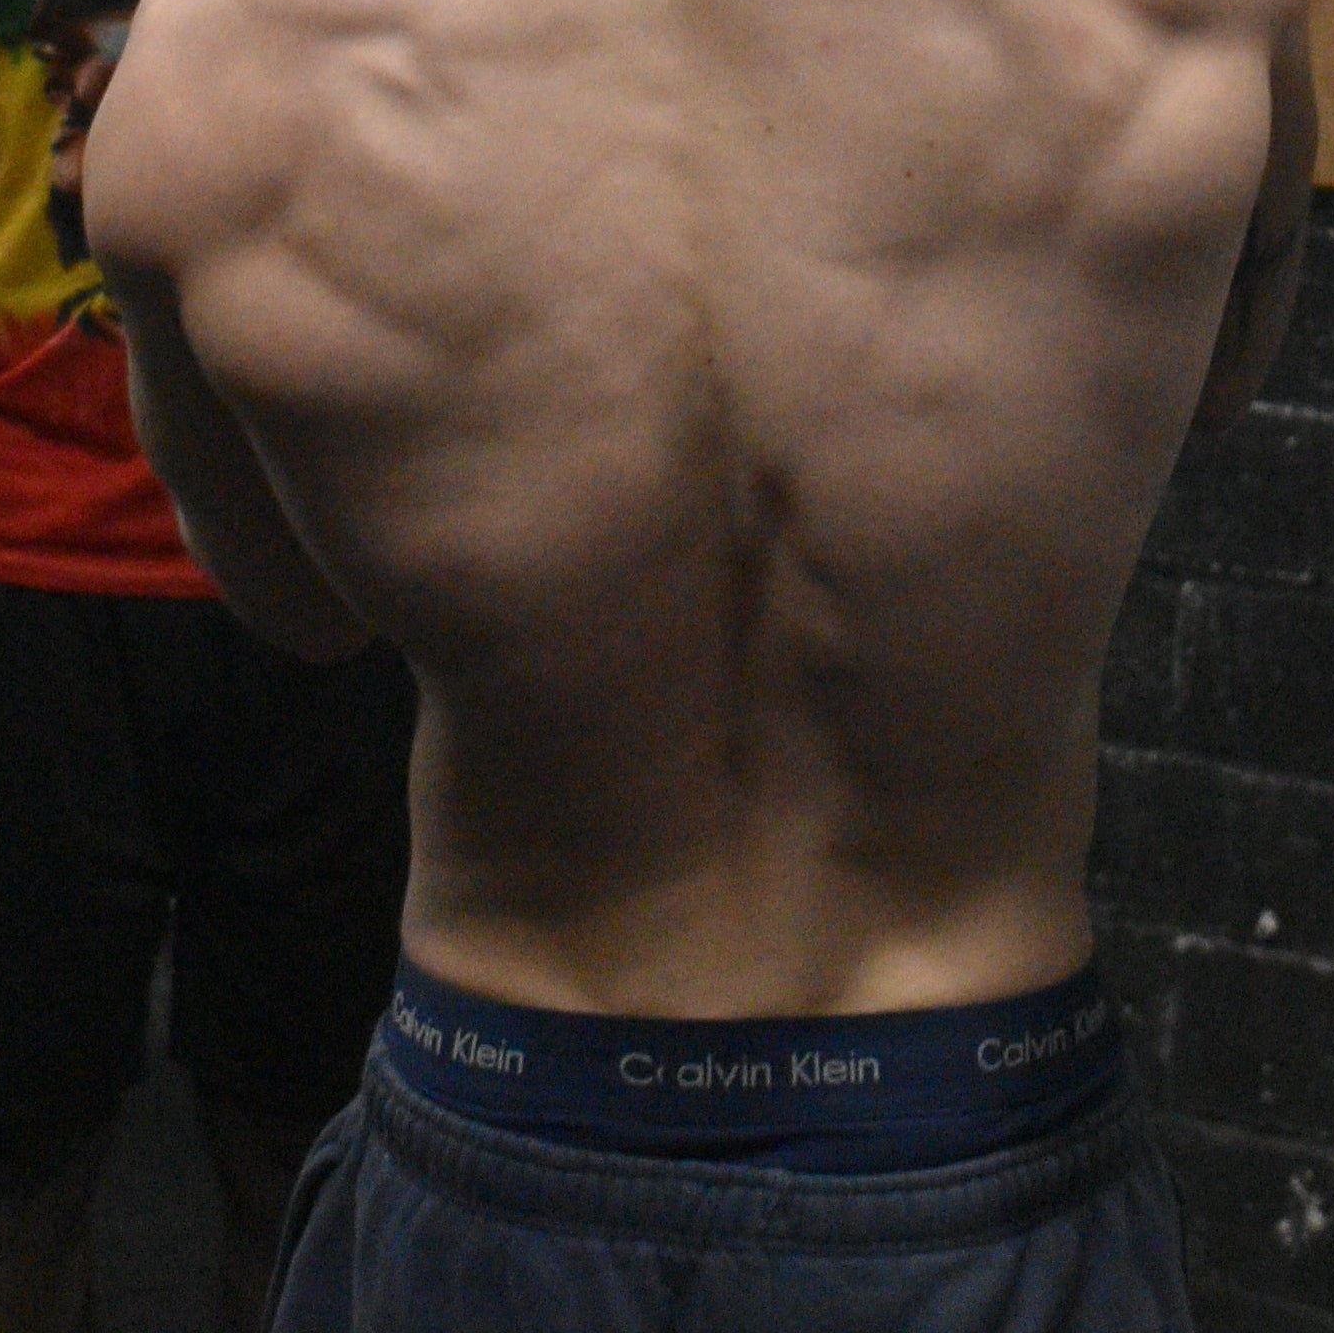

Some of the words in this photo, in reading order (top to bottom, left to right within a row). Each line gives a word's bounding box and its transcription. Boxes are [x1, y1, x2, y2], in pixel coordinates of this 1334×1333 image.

[392, 991, 443, 1056] Calvin
[451, 1029, 526, 1076] Klein
[976, 1026, 1067, 1074] Calvin
[791, 1050, 880, 1087] Klein
